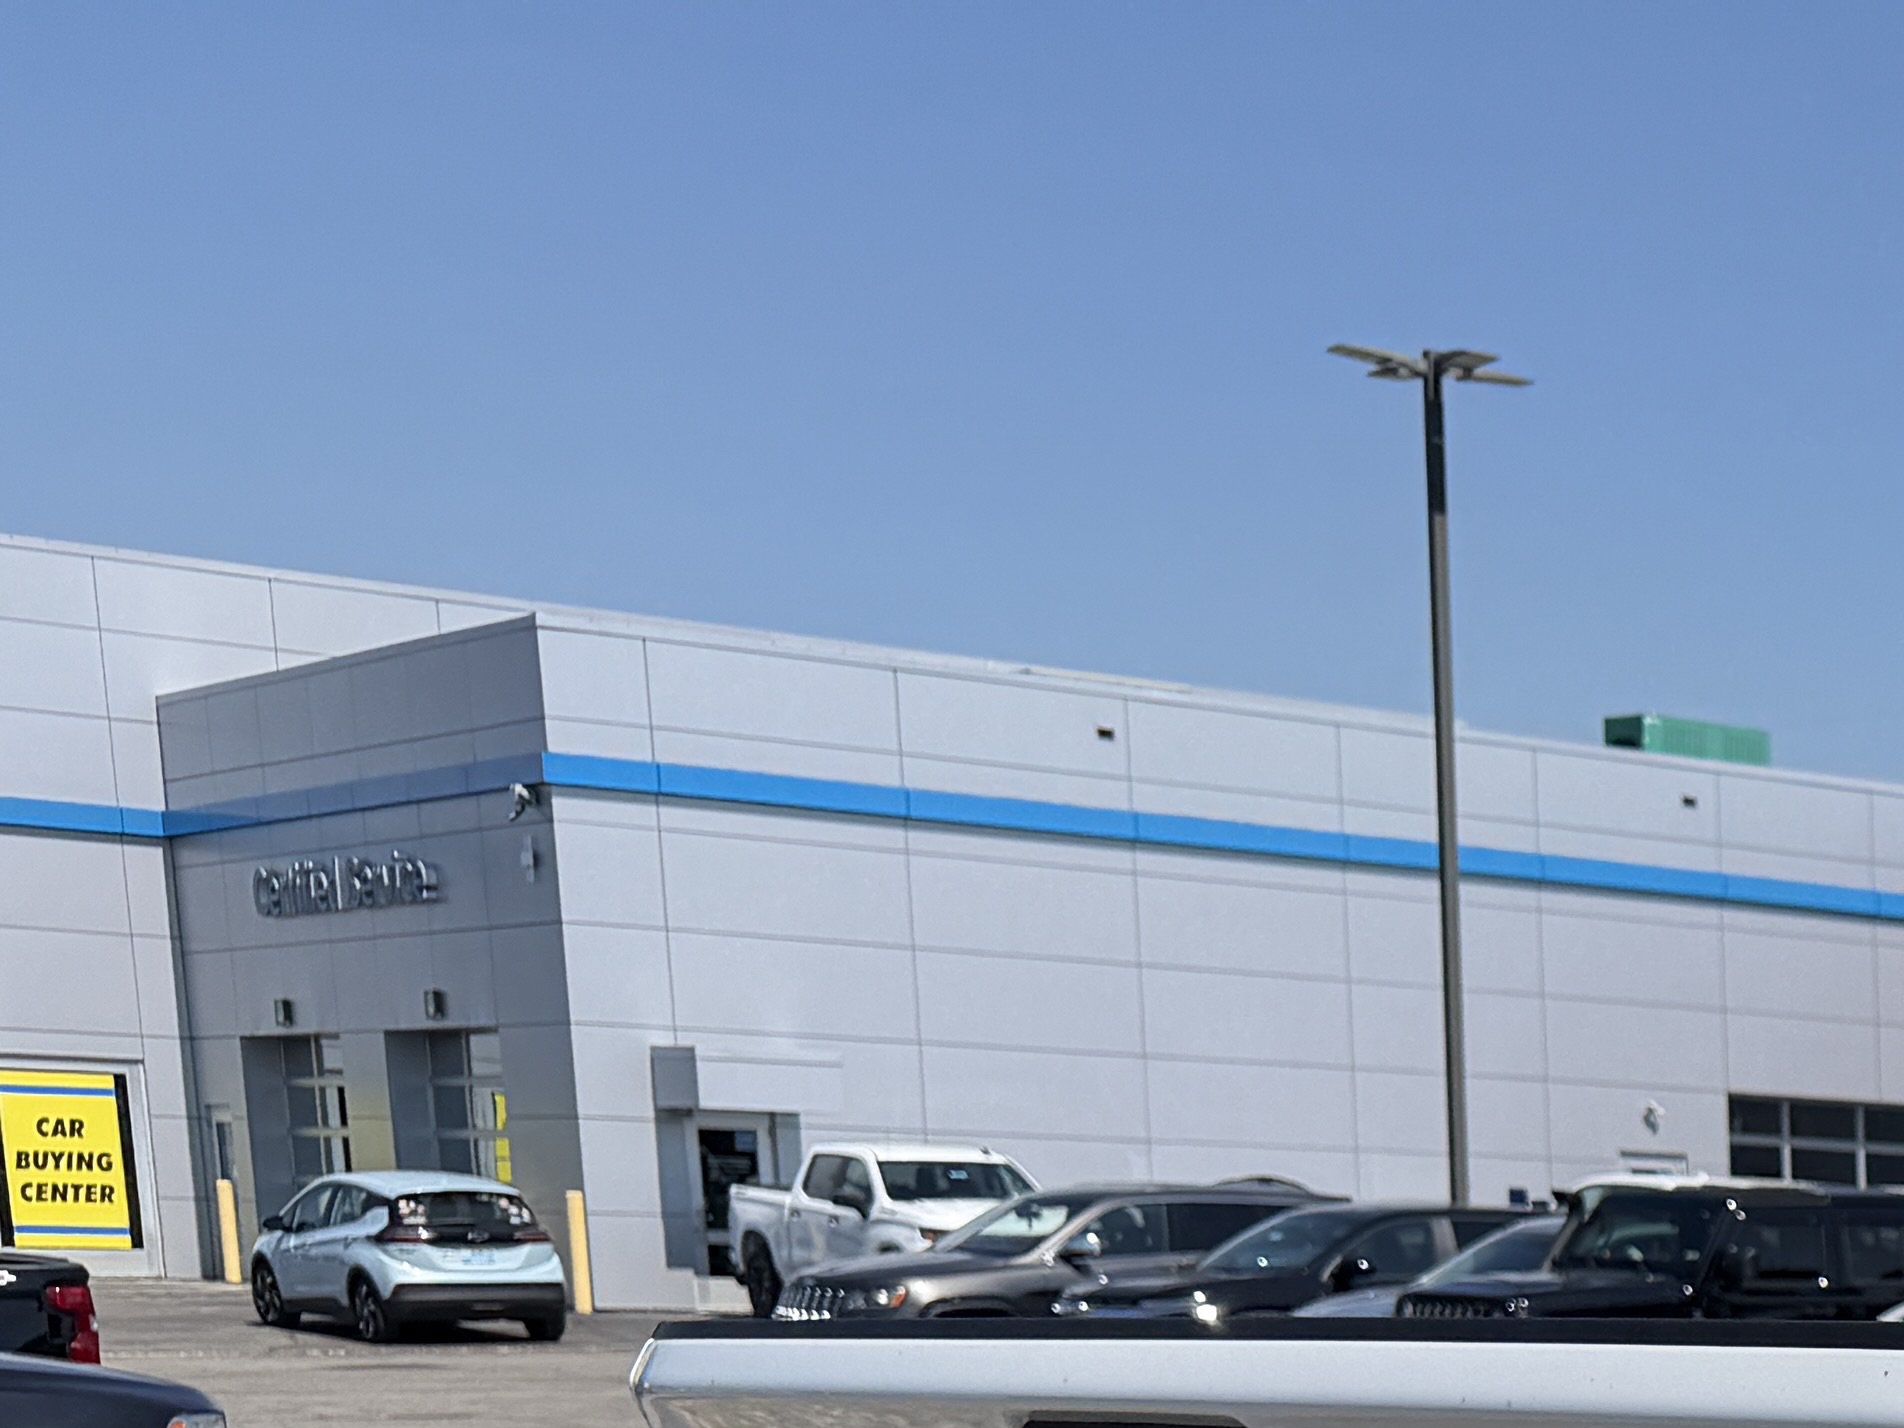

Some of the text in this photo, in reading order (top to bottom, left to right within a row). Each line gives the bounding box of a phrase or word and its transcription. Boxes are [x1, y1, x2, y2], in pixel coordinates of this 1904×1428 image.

[36, 1117, 85, 1138] CAR
[16, 1150, 113, 1172] BUYING
[20, 1182, 115, 1204] CENTER
